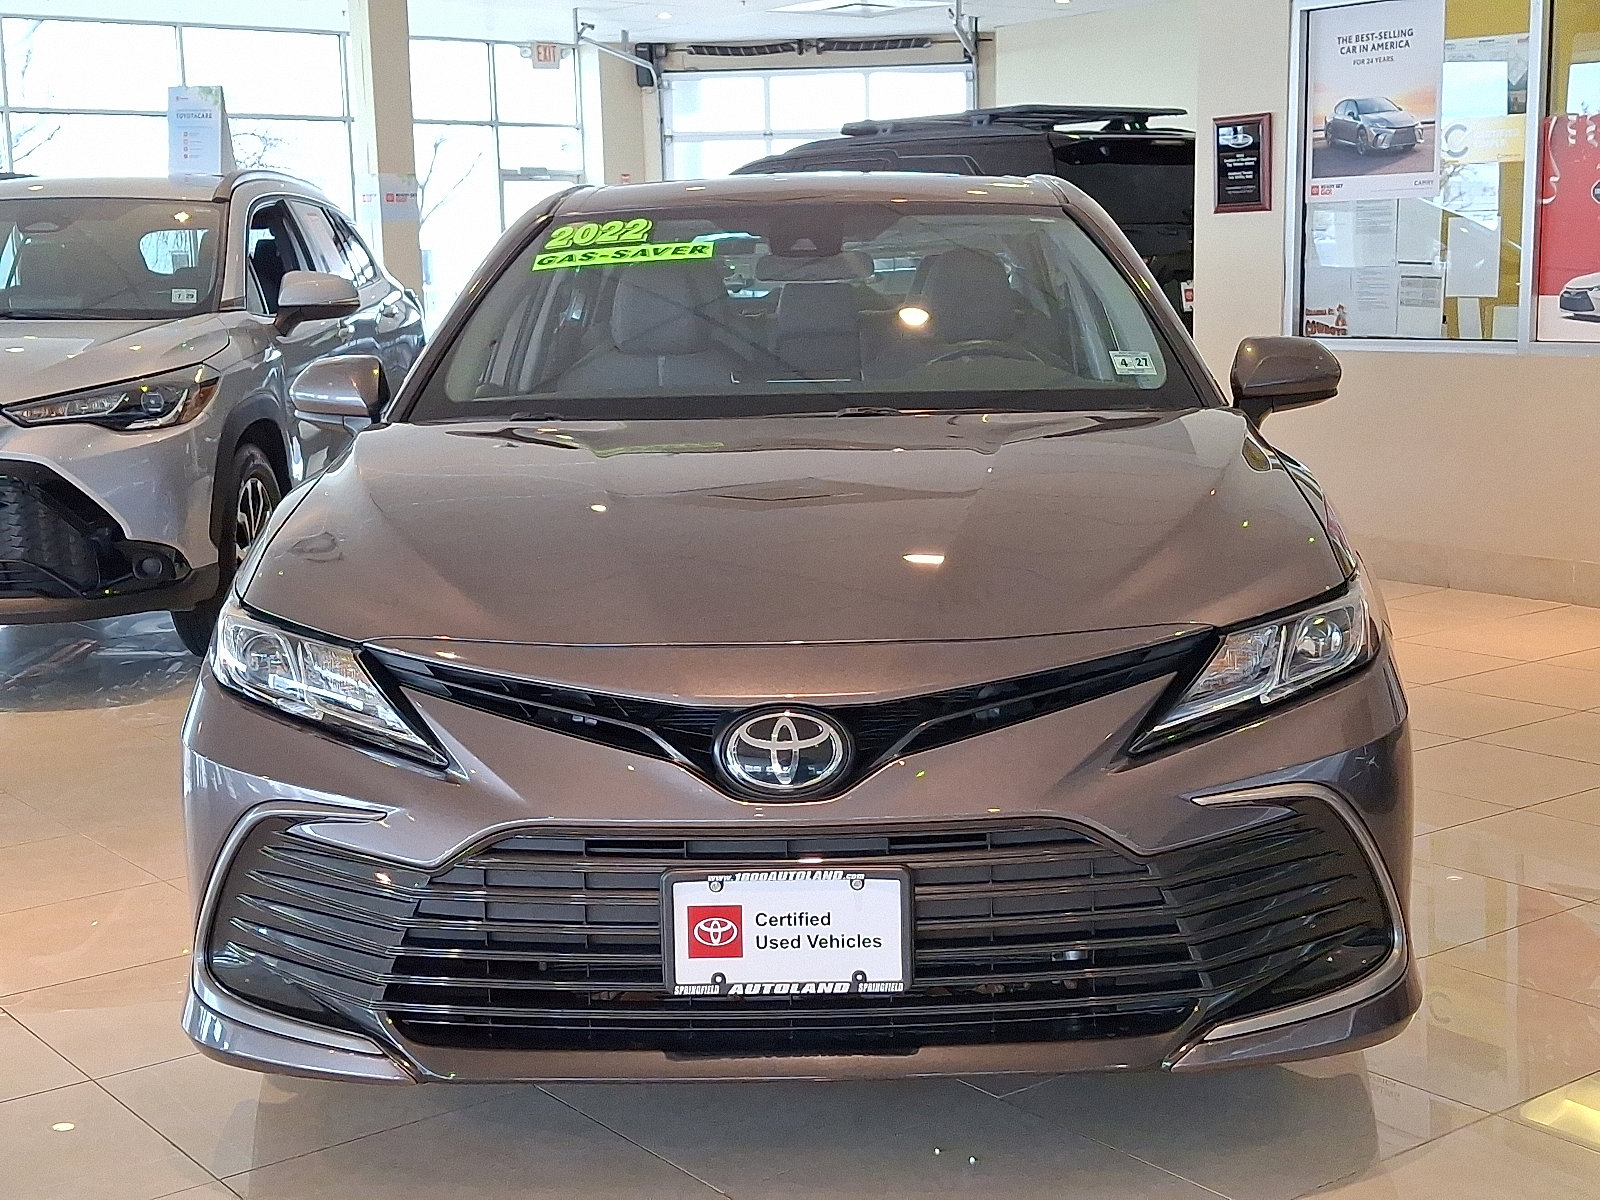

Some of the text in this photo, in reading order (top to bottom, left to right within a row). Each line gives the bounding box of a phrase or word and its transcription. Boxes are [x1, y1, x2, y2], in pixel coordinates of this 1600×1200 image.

[1337, 28, 1414, 45] THE BEST-SELLING
[536, 44, 557, 62] EXIT
[1339, 40, 1410, 55] CAR IN AMERICA
[1375, 55, 1394, 64] YEARS
[544, 217, 653, 250] 2022
[536, 244, 708, 267] GAS-SAVER
[1120, 357, 1149, 367] 4 27
[755, 911, 831, 927] Certified
[756, 933, 882, 949] Used Vehicles
[728, 983, 850, 995] AUTOLAND
